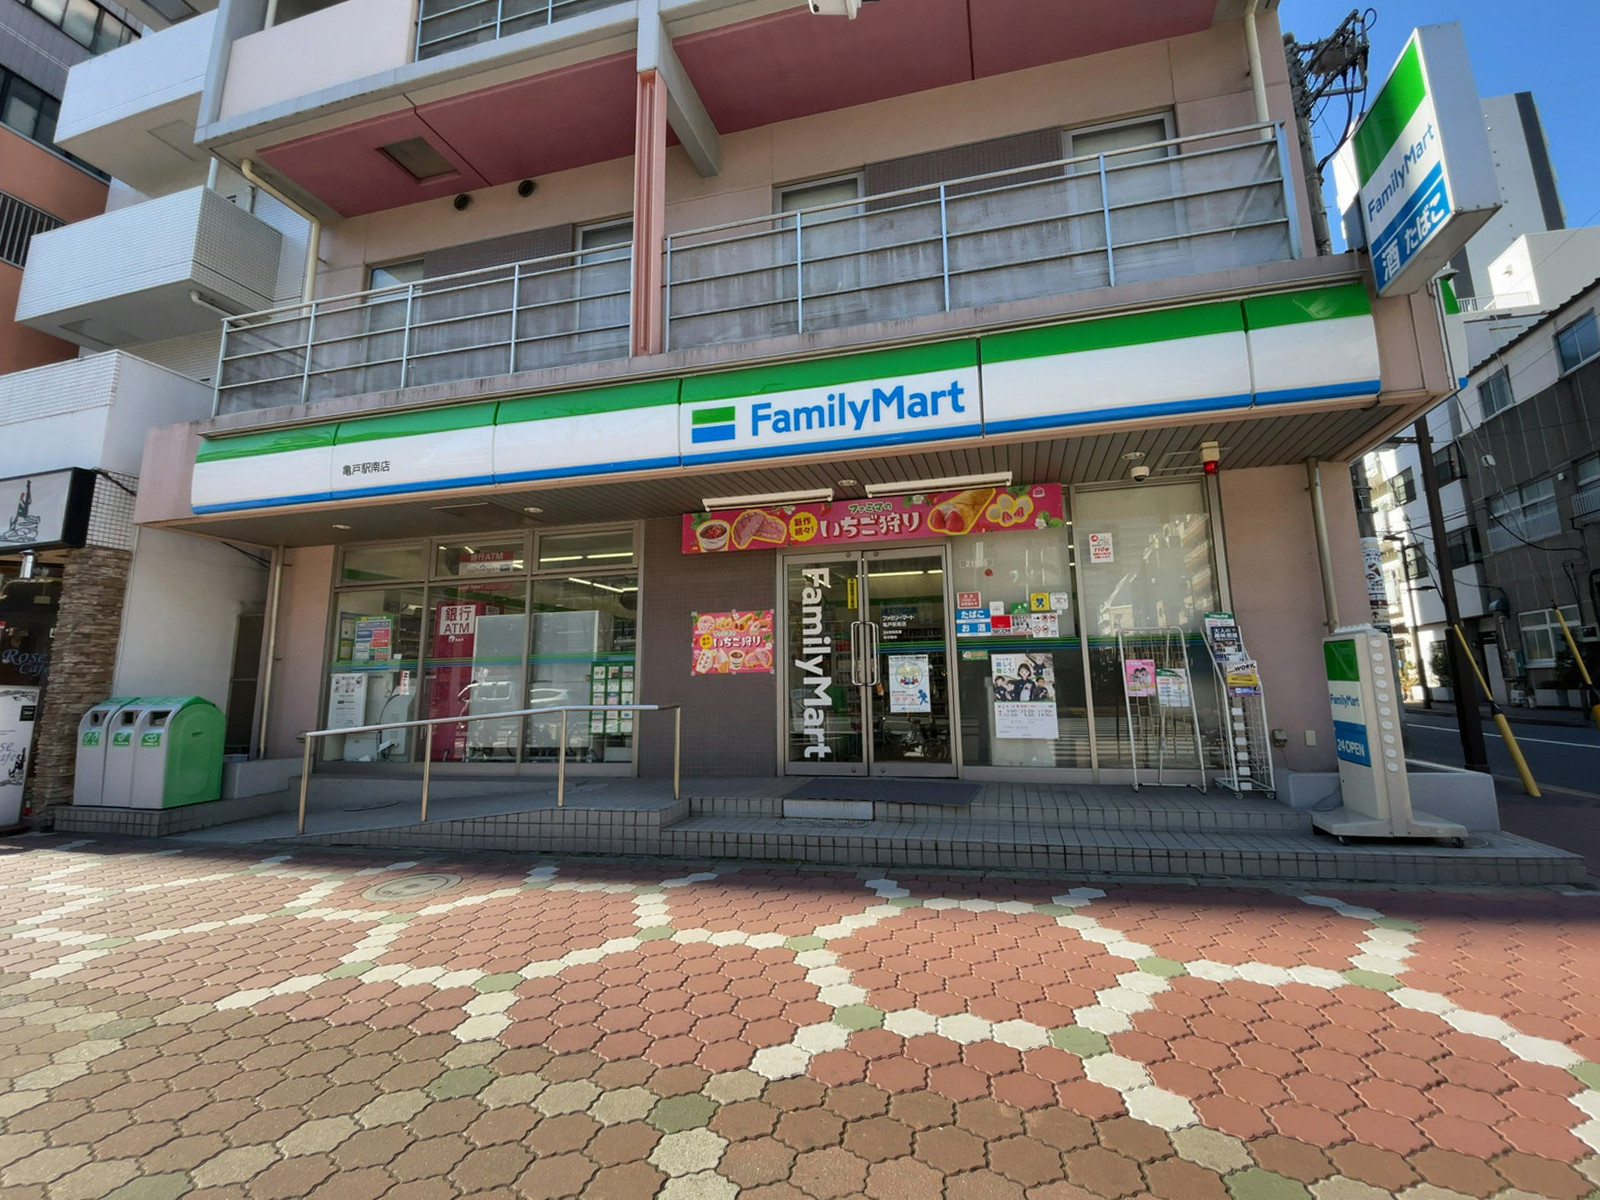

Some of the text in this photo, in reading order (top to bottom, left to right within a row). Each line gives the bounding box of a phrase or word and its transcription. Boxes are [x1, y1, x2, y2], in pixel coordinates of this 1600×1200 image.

[1367, 123, 1434, 222] FamilyMart
[1381, 192, 1444, 281] 酒 たばこ
[751, 380, 965, 436] FamilyMart
[342, 460, 391, 476] 亀戸駅南店
[848, 502, 892, 514] ファミマの
[820, 512, 920, 538] いちご狩り
[445, 606, 471, 622] 銀行
[961, 610, 985, 619] たばこ
[444, 622, 469, 634] ATM
[713, 635, 761, 648] いちご狩り
[795, 567, 832, 759] FamilyMart
[1330, 694, 1360, 708] FamilyMart
